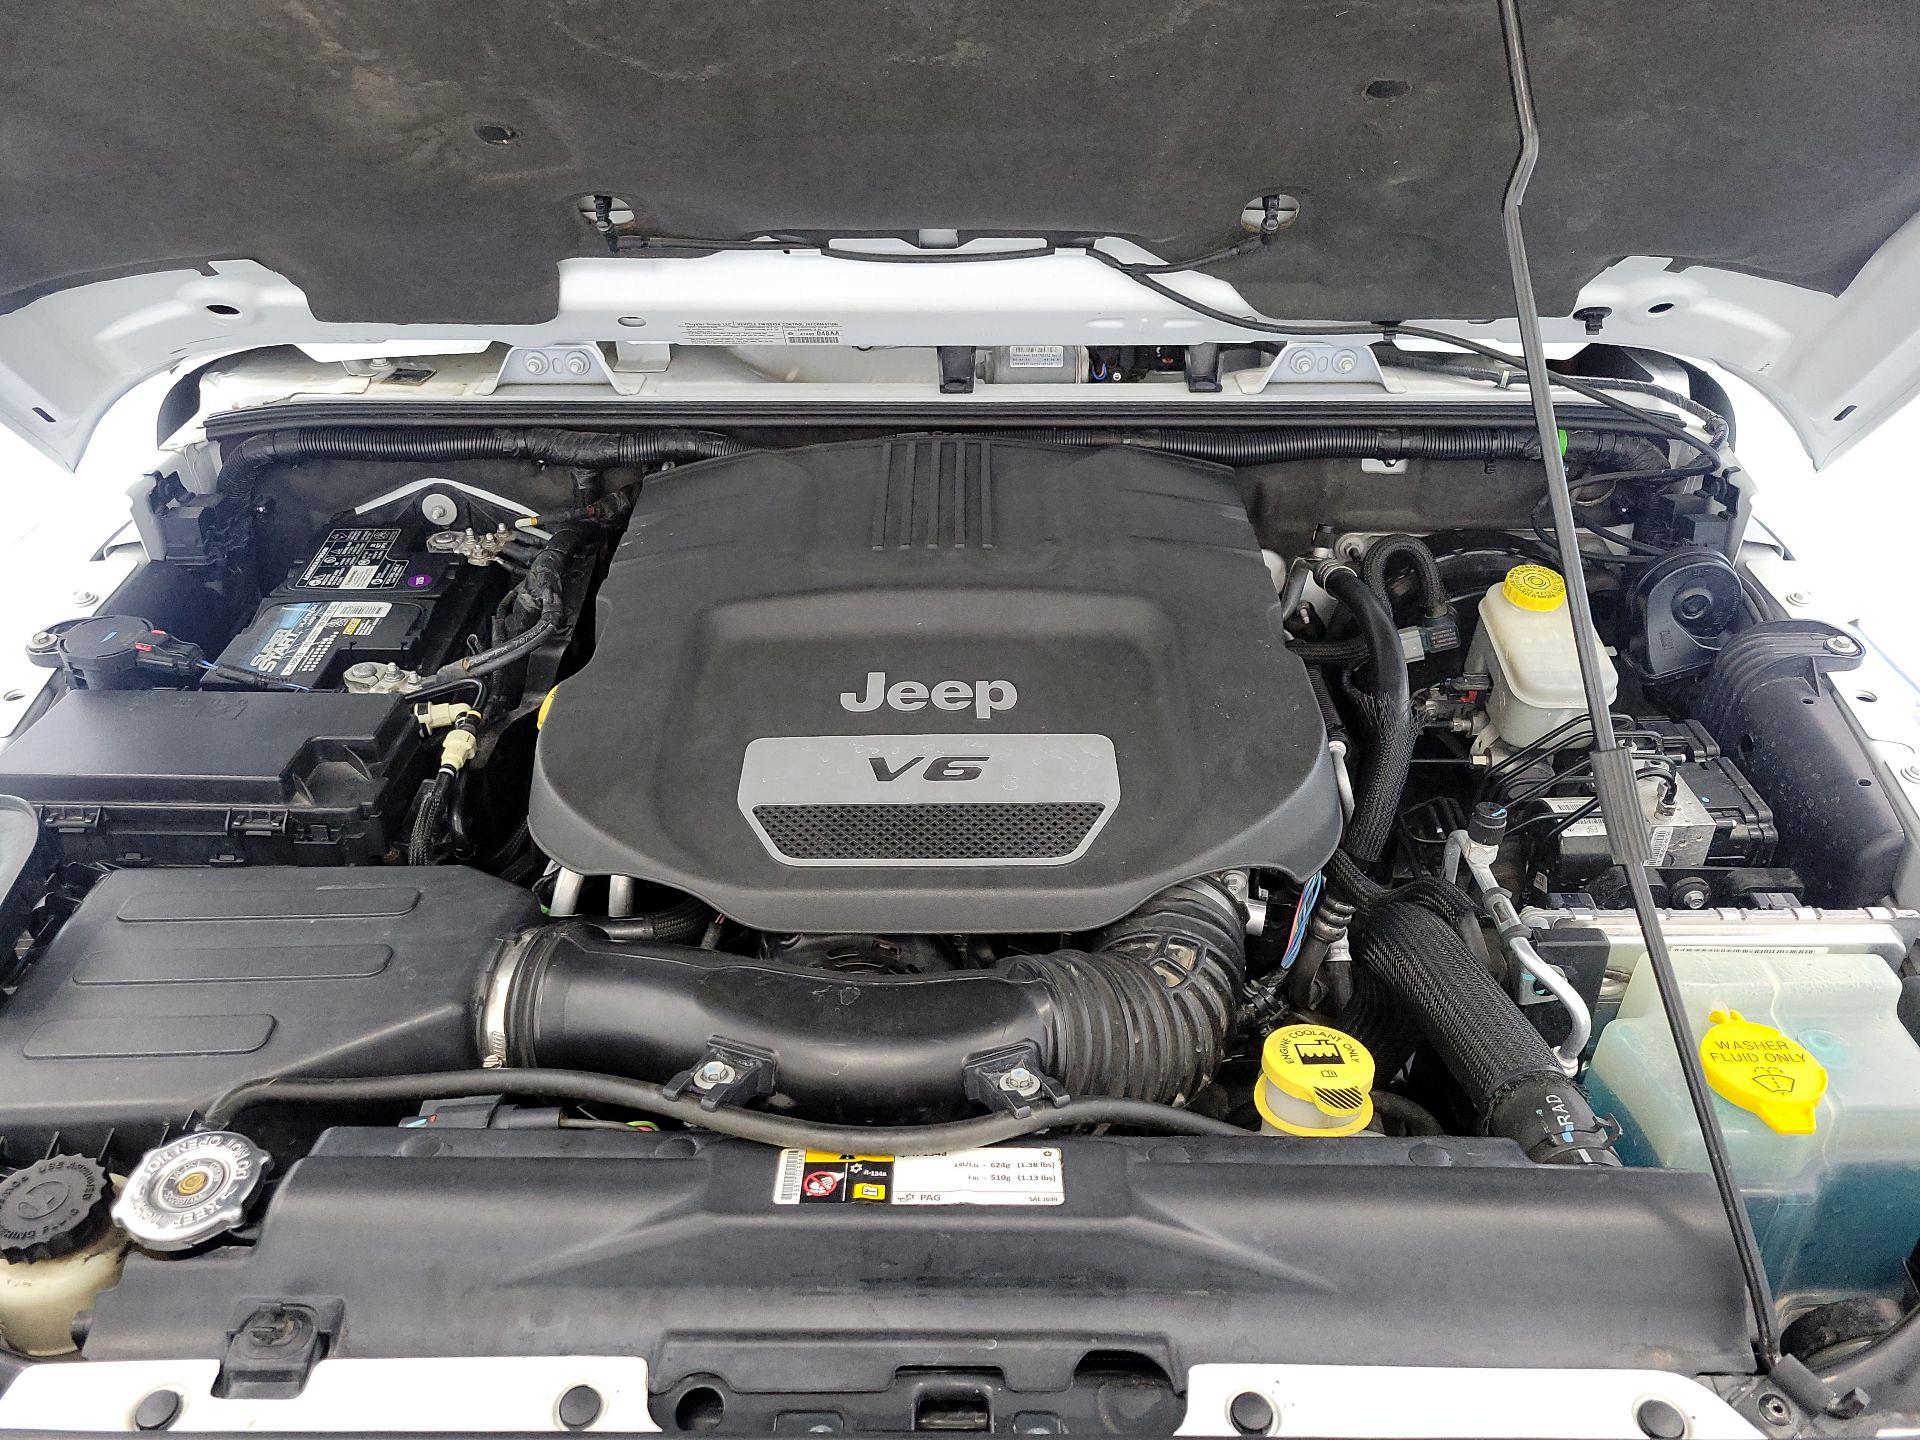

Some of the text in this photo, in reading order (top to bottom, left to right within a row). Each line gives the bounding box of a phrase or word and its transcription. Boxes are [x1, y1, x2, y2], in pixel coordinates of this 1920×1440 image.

[250, 629, 292, 667] SUPER
[257, 632, 302, 673] START
[840, 671, 1018, 719] Jeep
[868, 755, 991, 782] V6
[1279, 1029, 1360, 1065] ENGINE COOLANT ONLY
[1714, 1040, 1789, 1051] WASHER
[1709, 1052, 1807, 1063] FLUID ONLY
[1545, 1094, 1575, 1127] RAD
[176, 1134, 225, 1153] OPEN
[863, 1169, 888, 1177] R-134a
[1017, 1161, 1039, 1169] (1.38
[1040, 1161, 1055, 1169] lbs)
[990, 1174, 1011, 1182] 510g
[1017, 1174, 1039, 1182] (1.13
[1041, 1174, 1056, 1182] lbs)
[920, 1193, 942, 1202] PAG
